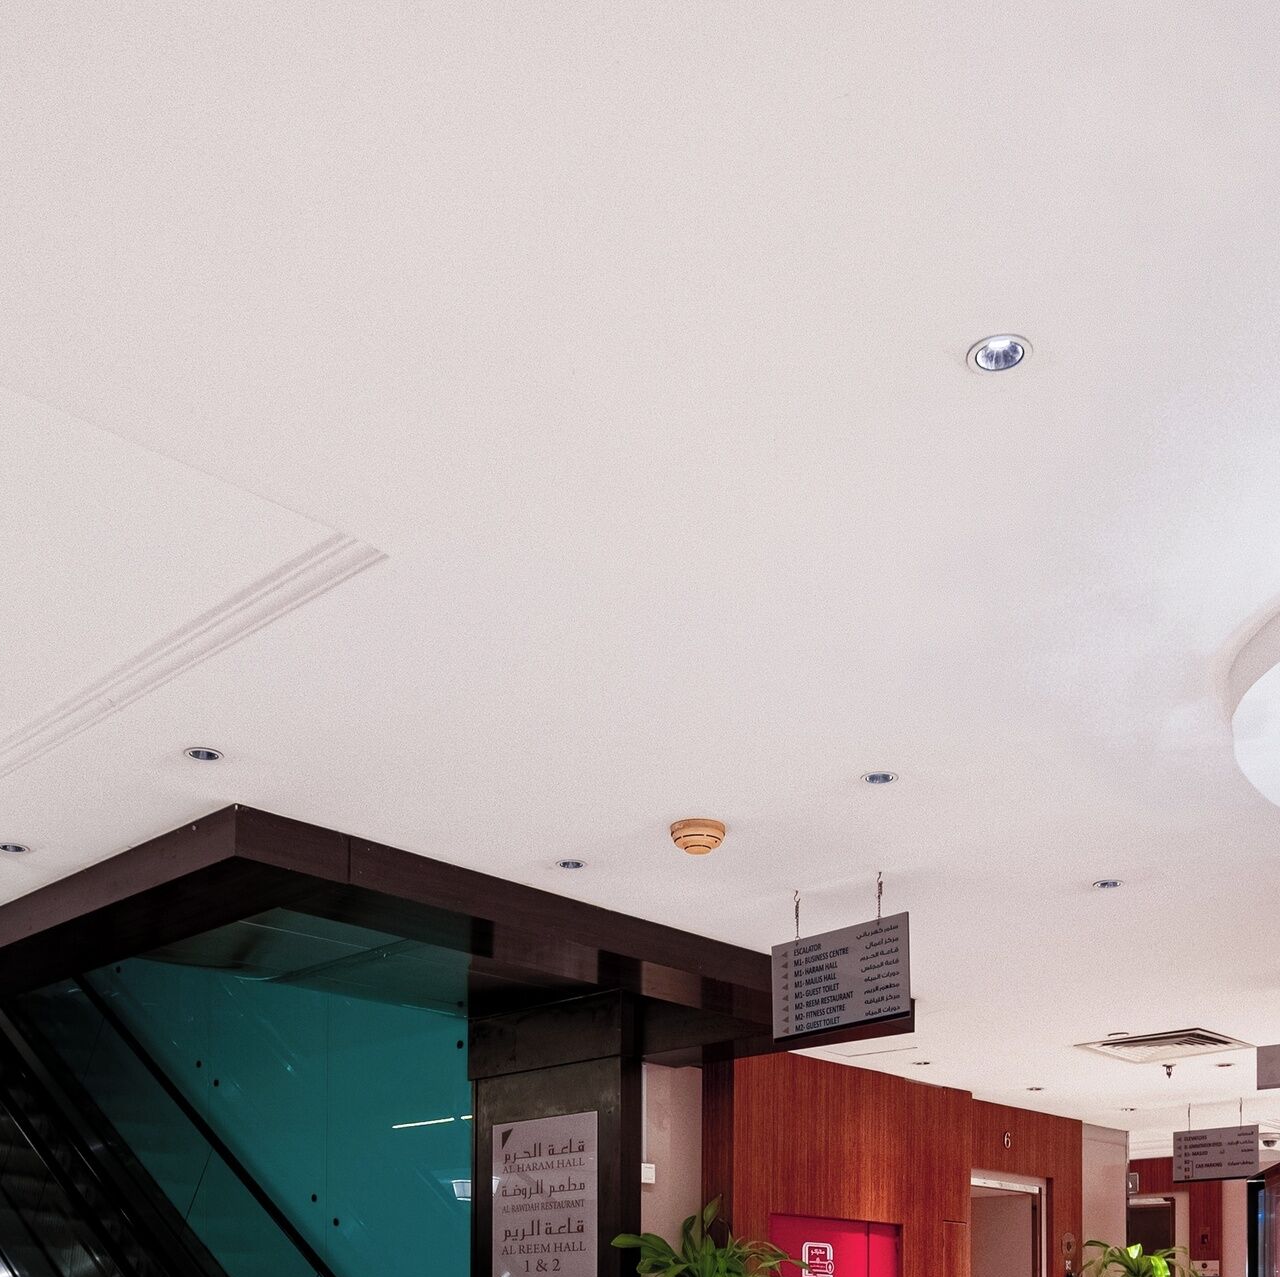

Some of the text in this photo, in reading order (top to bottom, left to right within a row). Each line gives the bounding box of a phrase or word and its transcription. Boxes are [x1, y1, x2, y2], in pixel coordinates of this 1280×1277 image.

[794, 943, 822, 956] ESCALATOR
[804, 950, 829, 964] BUSINESS
[830, 947, 849, 959] CENTRE
[804, 964, 824, 975] HARAM
[824, 962, 838, 972] HALL
[824, 973, 837, 984] HALL
[806, 986, 824, 998] GUEST
[823, 982, 840, 994] TOILET
[806, 997, 820, 1008] REEM
[820, 990, 854, 1005] RESTAURANT
[806, 1006, 826, 1019] FITNESS
[826, 1004, 846, 1014] CENTRE
[806, 1018, 824, 1030] GUEST
[824, 1016, 840, 1026] TOILET
[1004, 1132, 1011, 1149] 6
[504, 1138, 584, 1164] قاعة الحرم
[502, 1158, 585, 1174] AL HARAM HALL
[502, 1176, 586, 1200] مطعم الروضة
[502, 1199, 585, 1214] AL RAWDAH RESTAURANT
[504, 1217, 584, 1242] قاعة الريم
[502, 1242, 586, 1256] AL REEM HALL
[525, 1258, 560, 1272] 1 & 2
